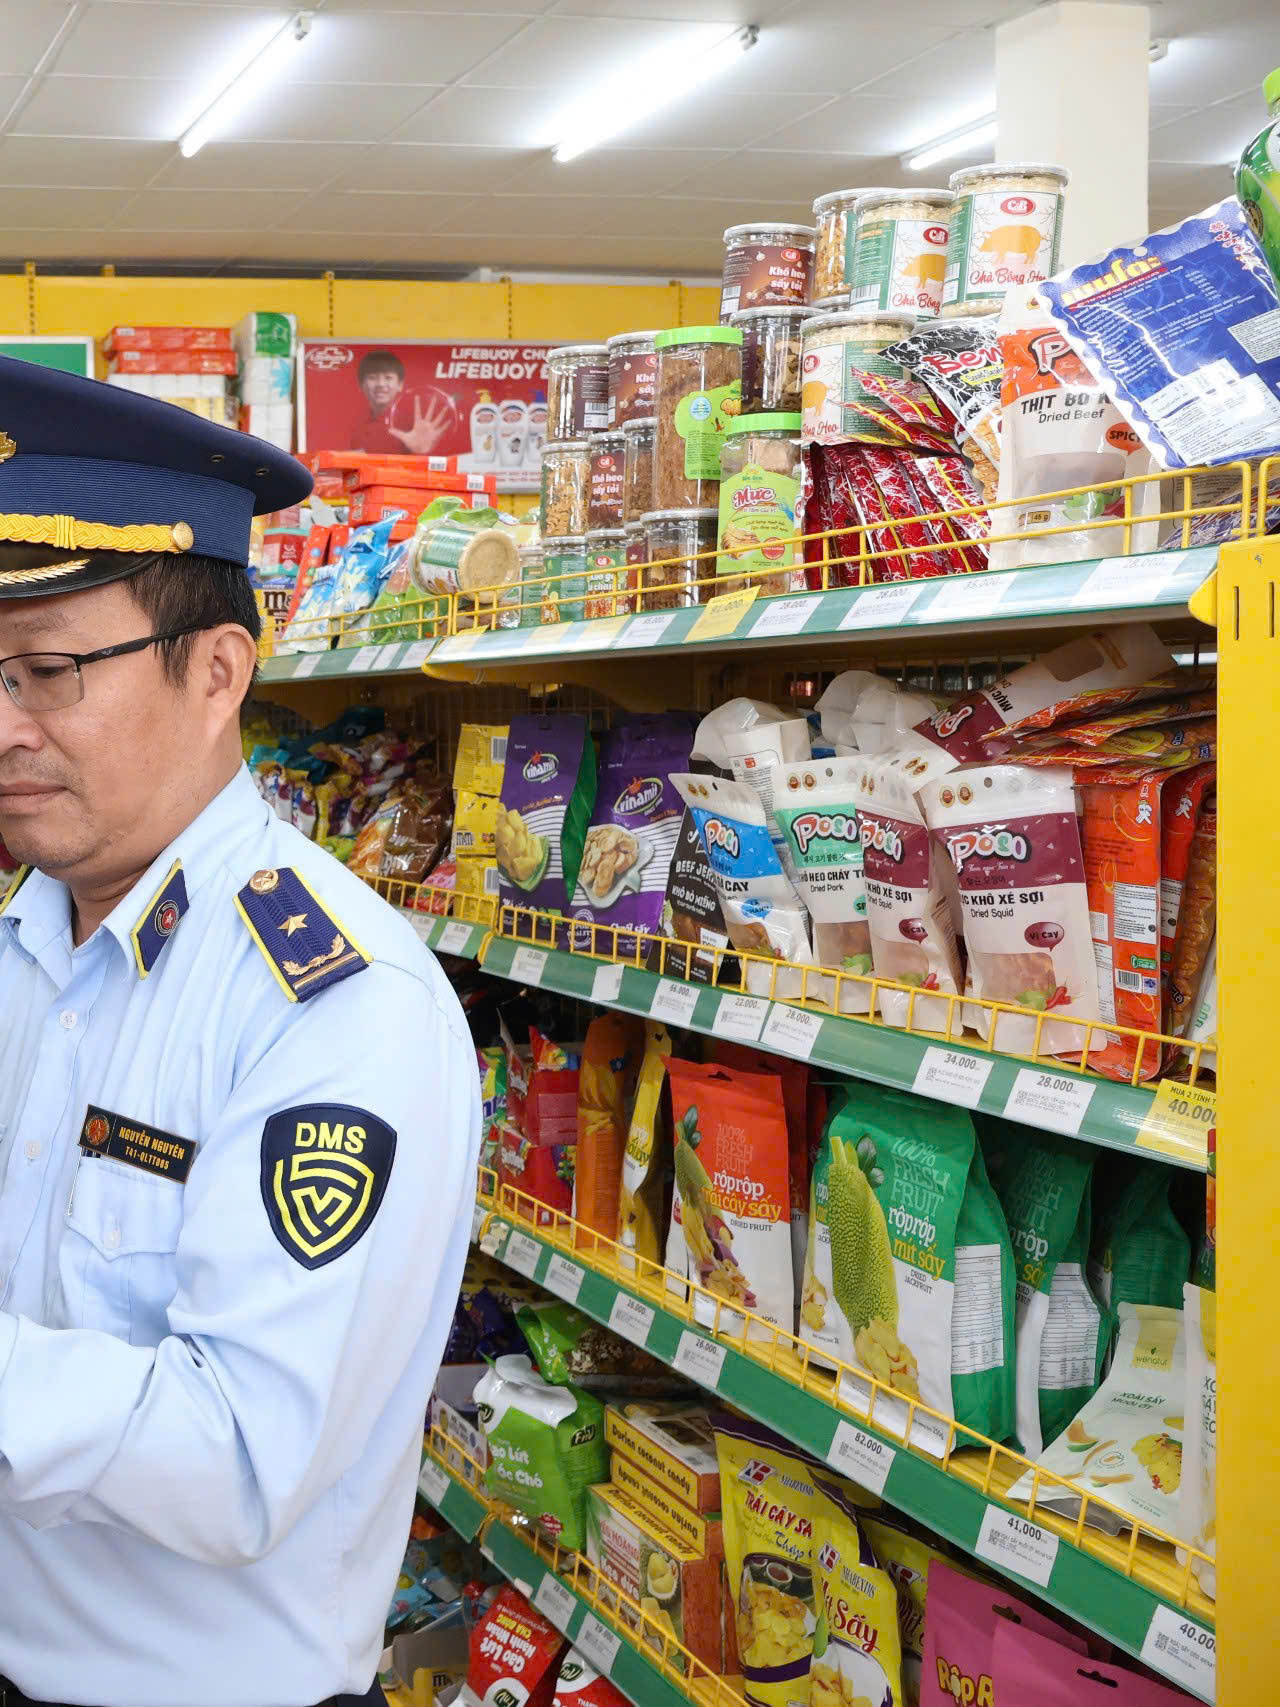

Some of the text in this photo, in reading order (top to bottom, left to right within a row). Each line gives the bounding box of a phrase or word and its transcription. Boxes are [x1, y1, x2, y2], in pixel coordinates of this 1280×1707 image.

[768, 265, 807, 280] Khô heo
[971, 267, 1026, 287] Chà Bông
[917, 292, 942, 316] Bông
[451, 348, 519, 361] LIFEBUOY
[435, 361, 536, 380] LIFEBUOY
[1020, 394, 1057, 415] THỊT
[1038, 408, 1105, 424] Dried Beef
[733, 486, 776, 509] Mực
[676, 860, 695, 874] BEEF
[725, 880, 750, 893] CAY
[970, 890, 1045, 907] KHÔ XÉ SỢI
[969, 907, 1014, 921] Dried Squid
[734, 997, 758, 1010] 22.000
[785, 1009, 811, 1025] 28.000
[944, 1053, 977, 1071] 34.000
[1036, 1075, 1074, 1093] 28.000
[1170, 1085, 1185, 1096] MUA
[294, 1121, 368, 1155] DMS
[891, 1137, 940, 1168] 100%
[715, 1152, 751, 1176] FRUIT
[892, 1155, 951, 1194] FRESH
[712, 1169, 766, 1203] rộprộp
[891, 1177, 946, 1217] FRUIT
[723, 1193, 748, 1219] cây
[747, 1193, 783, 1224] sấy
[729, 1218, 774, 1233] DRIED FRUIT
[887, 1203, 937, 1249] rộprộp
[892, 1236, 948, 1281] mít sấy
[903, 1274, 934, 1296] JACKFRUIT
[910, 1268, 928, 1283] DRIED
[695, 1337, 718, 1354] 26.000
[854, 1431, 883, 1456] 82.000
[611, 1423, 691, 1497] Durian coconut candy
[640, 1483, 671, 1515] coconut
[745, 1488, 797, 1530] TRÁI CÂY
[670, 1510, 699, 1540] Durian
[1007, 1516, 1042, 1541] 41.000
[833, 1599, 882, 1655] Sấy
